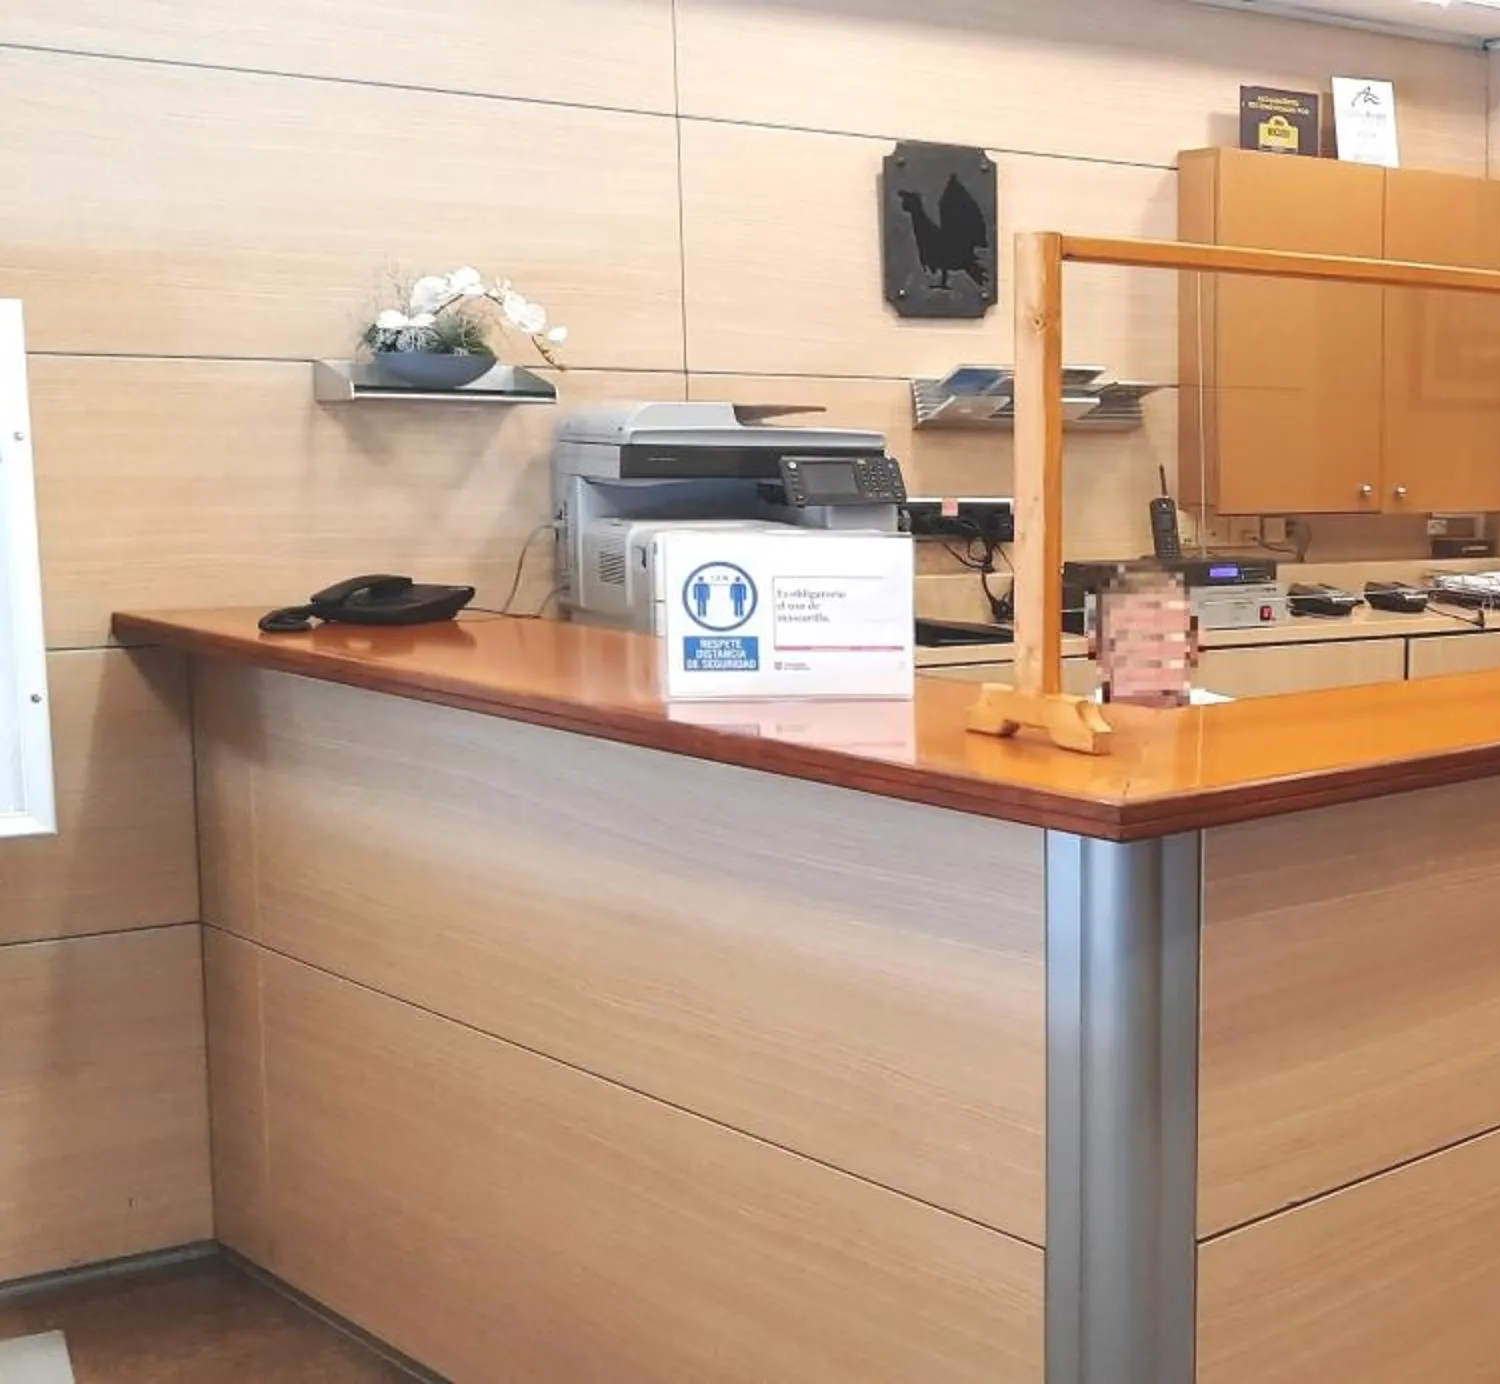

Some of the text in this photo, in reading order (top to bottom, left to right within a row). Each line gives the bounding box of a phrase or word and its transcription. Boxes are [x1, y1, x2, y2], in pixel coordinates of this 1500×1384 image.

[700, 639, 742, 649] RESPETE
[695, 649, 747, 659] DISTANCIA
[687, 659, 757, 669] DE SEGURIDAD
